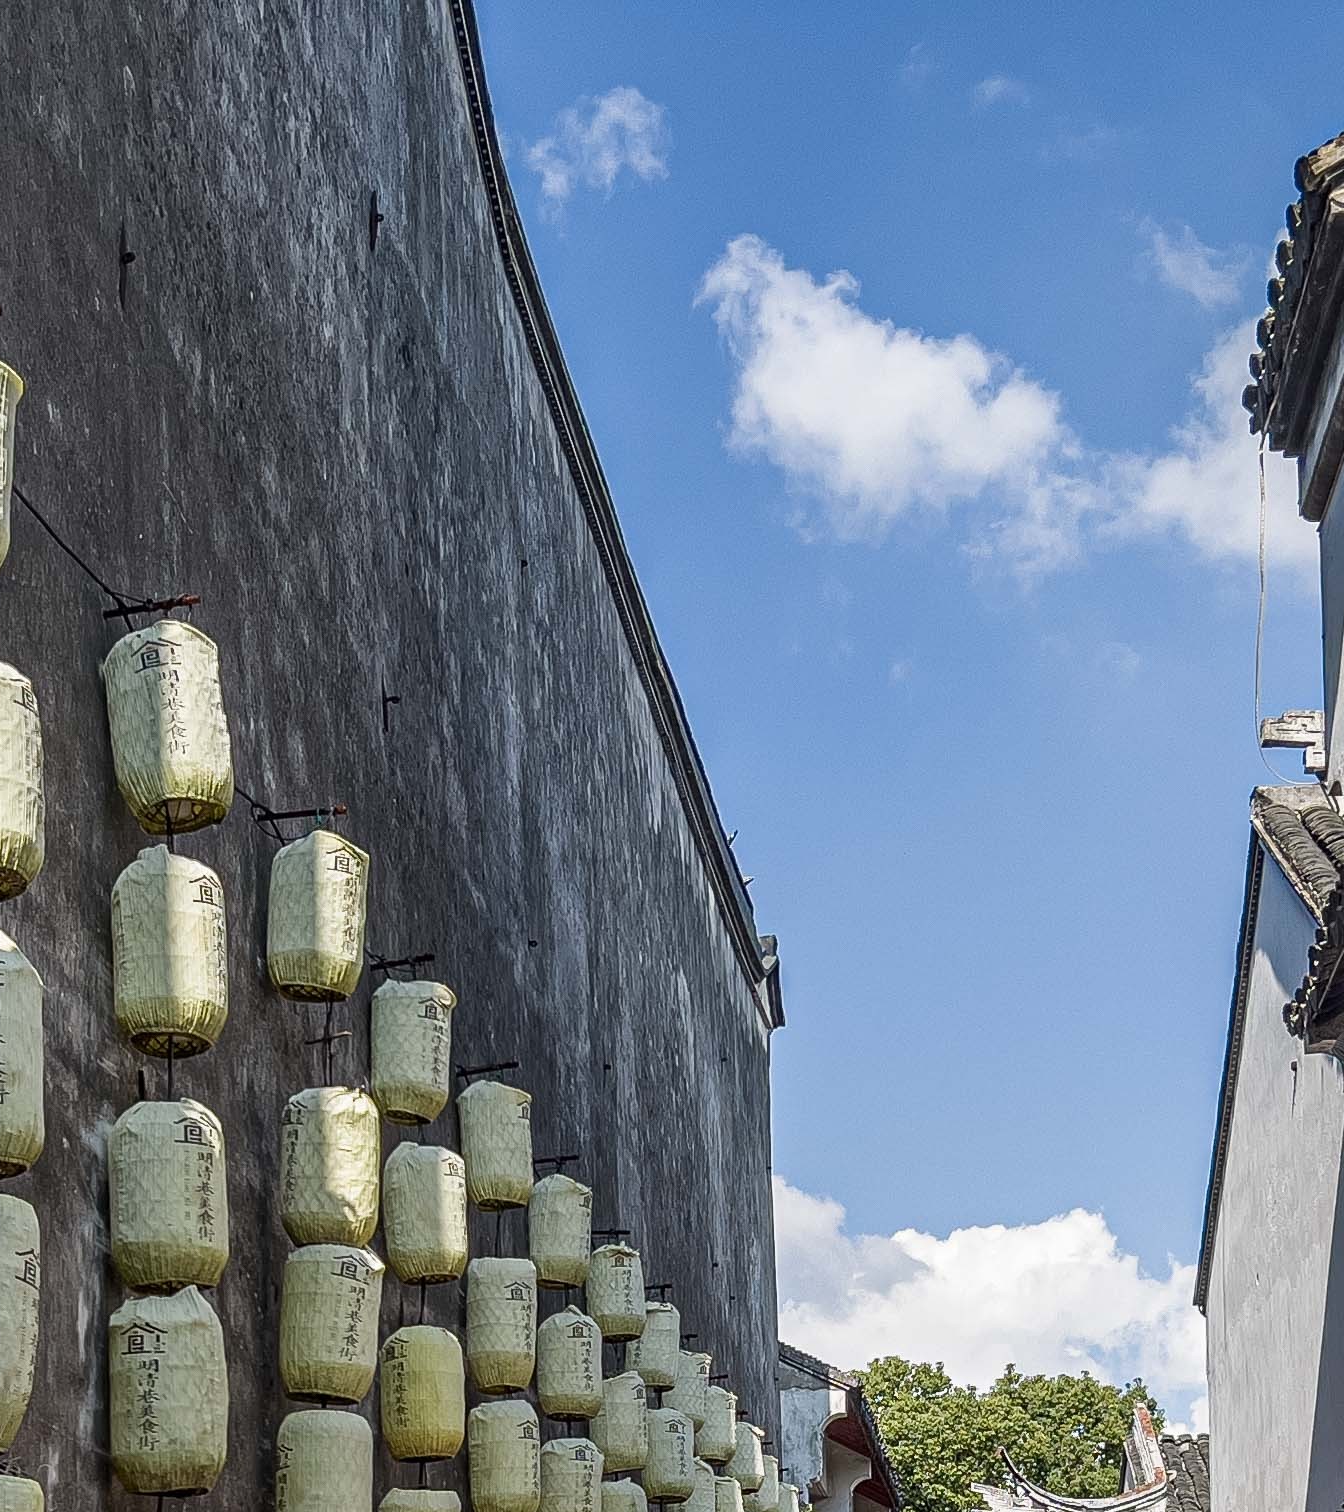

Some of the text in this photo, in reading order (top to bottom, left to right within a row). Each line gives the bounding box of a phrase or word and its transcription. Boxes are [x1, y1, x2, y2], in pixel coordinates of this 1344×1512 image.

[157, 669, 190, 755] 明清巷美食街
[196, 1152, 215, 1242] 明清巷美食街
[340, 1286, 366, 1361] 明清巷美食街
[137, 1359, 160, 1451] 明清巷美食街
